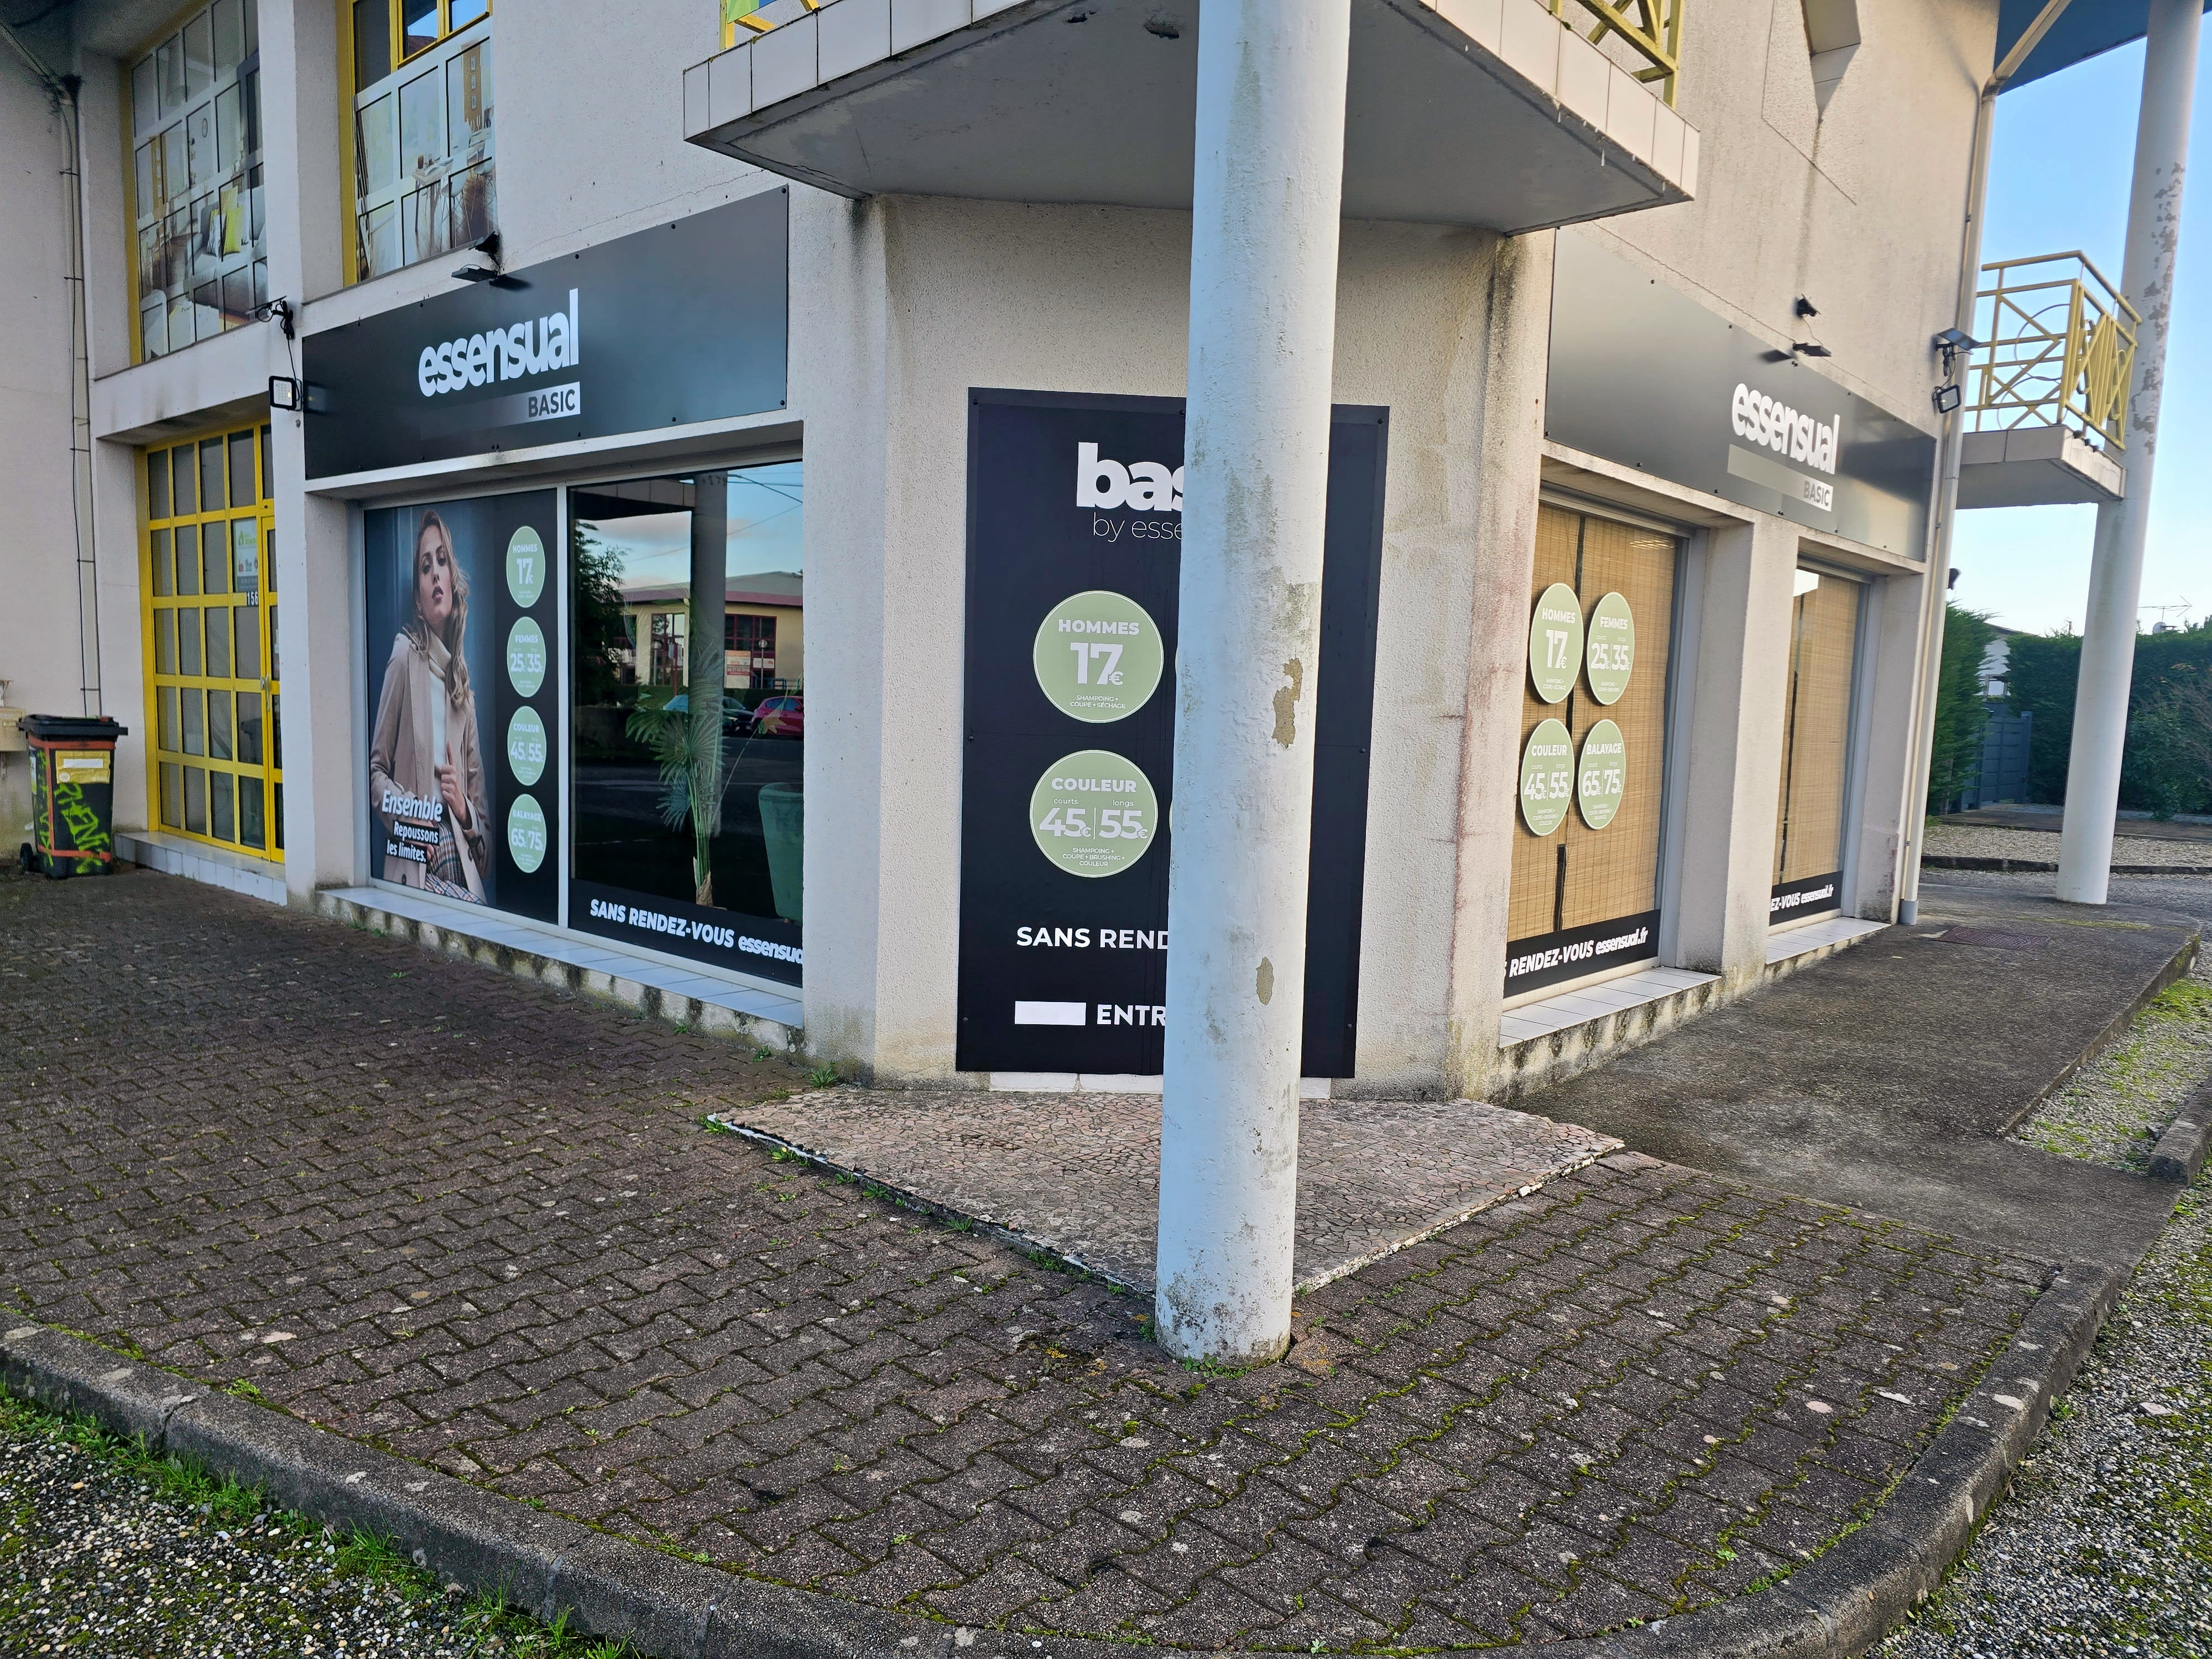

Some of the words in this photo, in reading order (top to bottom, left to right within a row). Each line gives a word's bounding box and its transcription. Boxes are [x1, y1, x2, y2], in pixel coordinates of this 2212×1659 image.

[419, 288, 579, 397] essensual
[528, 389, 576, 418] BASIC
[1732, 383, 1840, 475] essensual
[1804, 479, 1830, 507] BASIC
[1093, 512, 1125, 542] by
[513, 543, 538, 554] HOMMES
[247, 591, 258, 606] 156
[1058, 619, 1140, 635] HOMMES
[1542, 608, 1575, 624] HOMMES
[1600, 616, 1628, 630] FEMMES
[515, 634, 539, 644] FEMMES
[1546, 629, 1568, 669] 17€
[1070, 642, 1124, 686] 17€
[513, 723, 540, 733] COULEUR
[1531, 744, 1567, 757] COULEUR
[1587, 743, 1622, 755] BALAYAGE
[1051, 778, 1136, 792] COULEUR
[1524, 773, 1547, 800] 45€
[1549, 771, 1570, 799] 55€
[1582, 770, 1601, 797] 65€
[1604, 769, 1622, 795] 75€
[382, 789, 443, 822] Ensemble
[1112, 799, 1134, 808] longs
[512, 809, 542, 822] BALAYAGE
[1039, 807, 1092, 837] 45€
[1098, 809, 1148, 839] 55€
[394, 820, 439, 844] Repoussons
[387, 839, 397, 856] les
[399, 842, 426, 862] limites.
[590, 899, 626, 923] SANS
[629, 907, 734, 948] RENDEZ-VOUS
[1016, 926, 1091, 948] SANS
[1509, 940, 1594, 978] RENDEZ-VOUS
[1595, 927, 1648, 955] essensual.fr
[1097, 1004, 1166, 1026] ENTR
